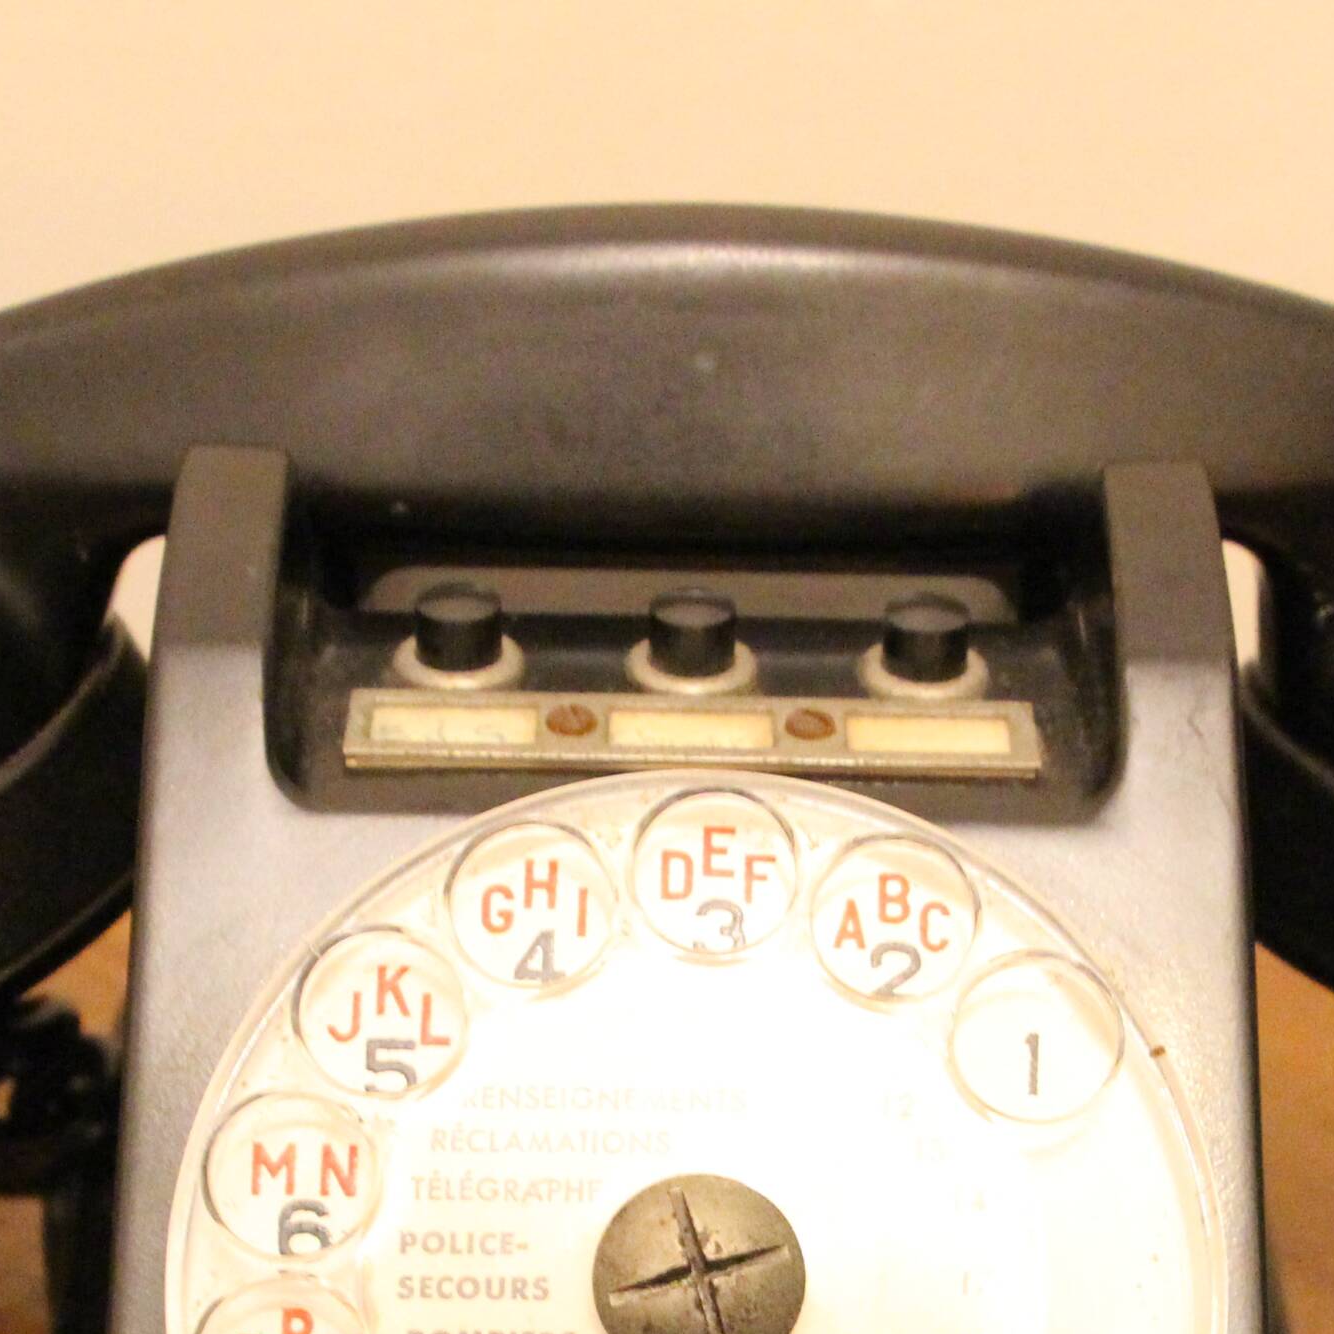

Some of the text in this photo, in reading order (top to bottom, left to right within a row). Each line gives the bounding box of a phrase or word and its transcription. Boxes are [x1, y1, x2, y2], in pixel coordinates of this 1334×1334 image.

[660, 825, 776, 904] DEF
[480, 858, 588, 936] GHI
[693, 898, 746, 949] 3
[833, 873, 950, 953] ABC
[513, 930, 565, 984] 4
[870, 942, 922, 997] 2
[327, 965, 451, 1046] JKL
[365, 1038, 417, 1092] 5
[1025, 1032, 1040, 1096] 1
[277, 1199, 332, 1256] 6
[398, 1231, 529, 1255] POLICE-
[396, 1276, 550, 1301] SECOURS
